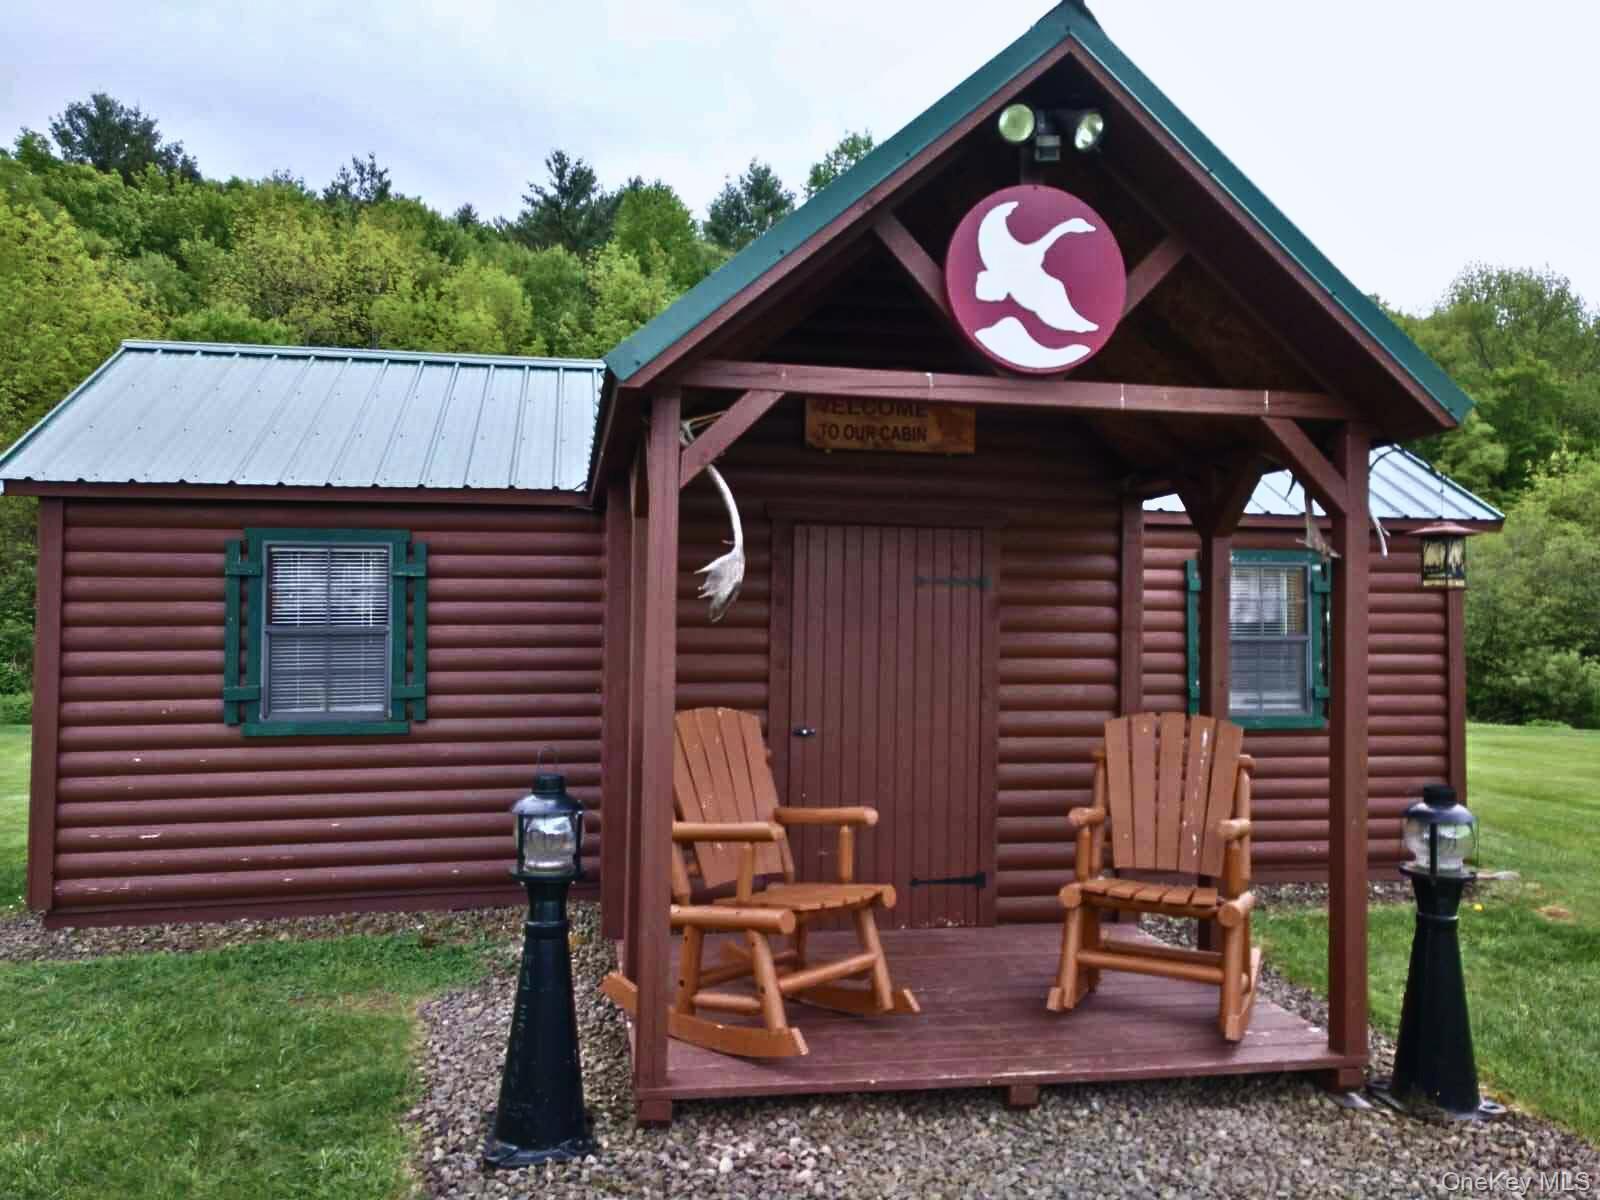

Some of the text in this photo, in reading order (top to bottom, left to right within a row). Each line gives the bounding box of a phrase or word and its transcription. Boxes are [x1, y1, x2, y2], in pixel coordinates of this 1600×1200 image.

[818, 423, 928, 442] TO OUR CABIN
